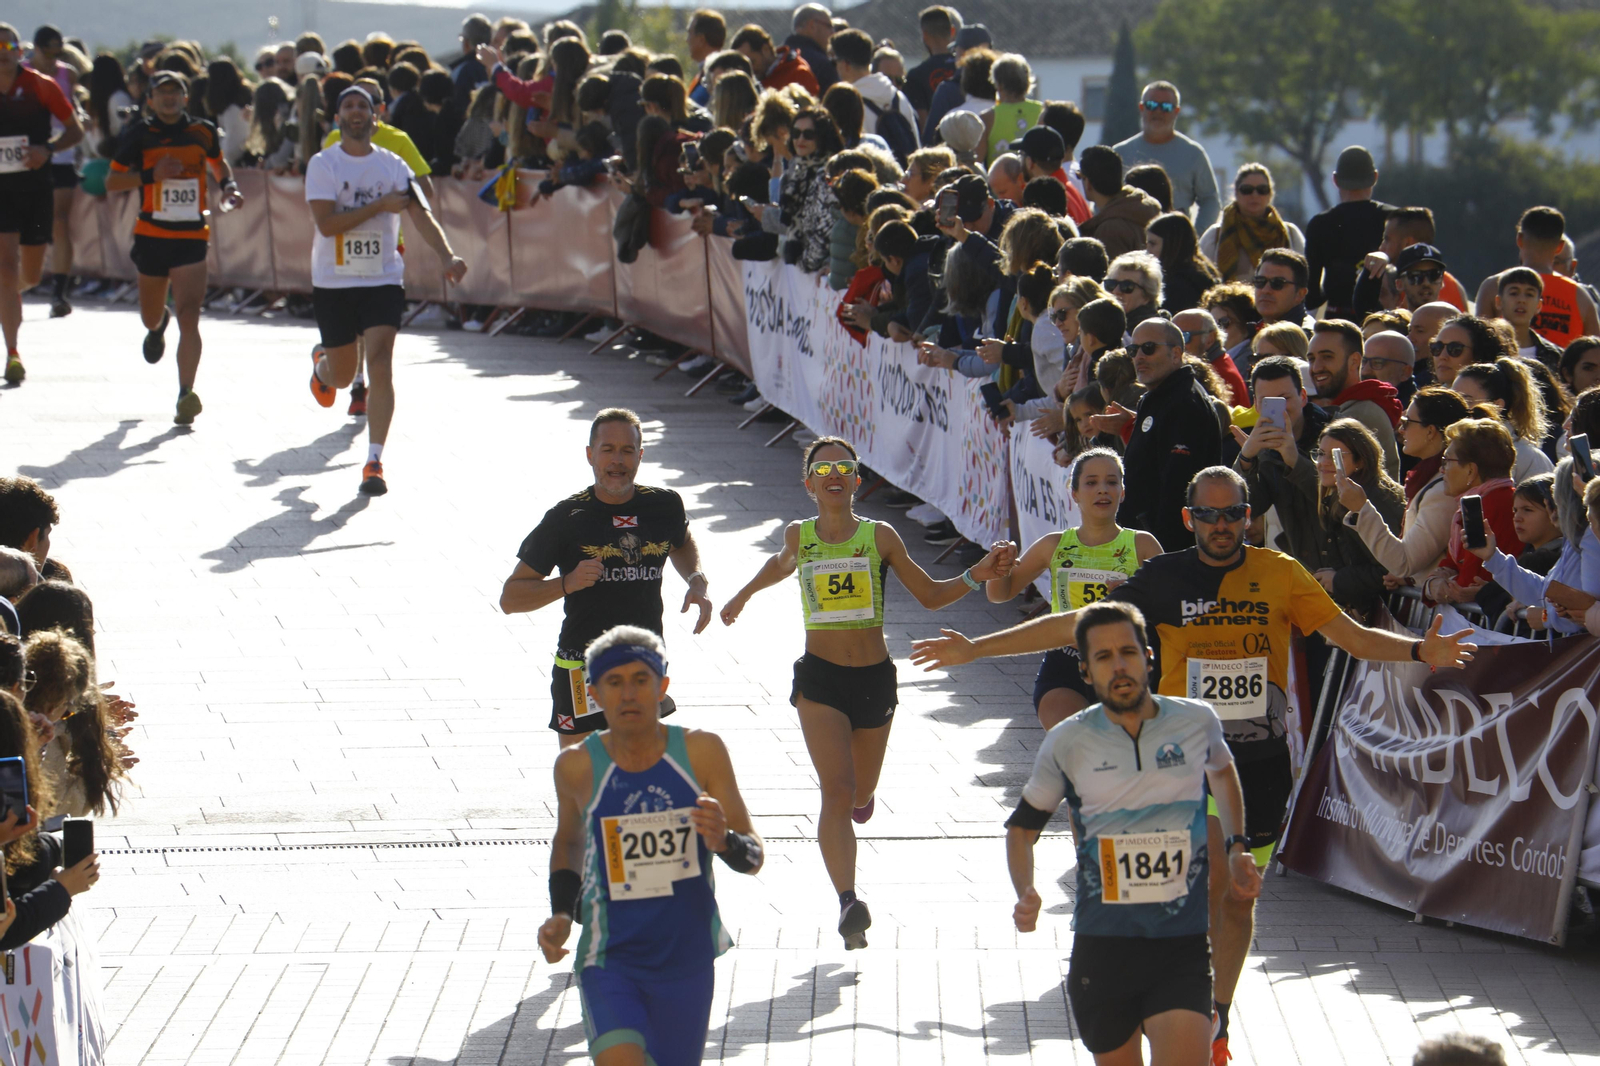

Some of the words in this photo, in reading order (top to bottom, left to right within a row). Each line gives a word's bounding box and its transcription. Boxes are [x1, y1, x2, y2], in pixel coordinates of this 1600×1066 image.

[0, 147, 22, 161] 08
[163, 189, 196, 203] 1303
[345, 240, 380, 255] 1813
[821, 562, 848, 570] IMDECO
[828, 572, 855, 595] 54
[1083, 584, 1109, 604] 53
[1181, 598, 1270, 616] bichos
[1181, 615, 1269, 627] runners
[1188, 641, 1212, 649] Colegio
[1213, 640, 1236, 648] Oficial
[1205, 648, 1237, 656] Gestores
[1211, 662, 1242, 670] IMDECO
[1202, 674, 1262, 700] 2886
[623, 826, 691, 860] 2037
[1125, 836, 1162, 845] IMDECO
[1434, 821, 1506, 868] Deportes
[1118, 849, 1183, 879] 1841
